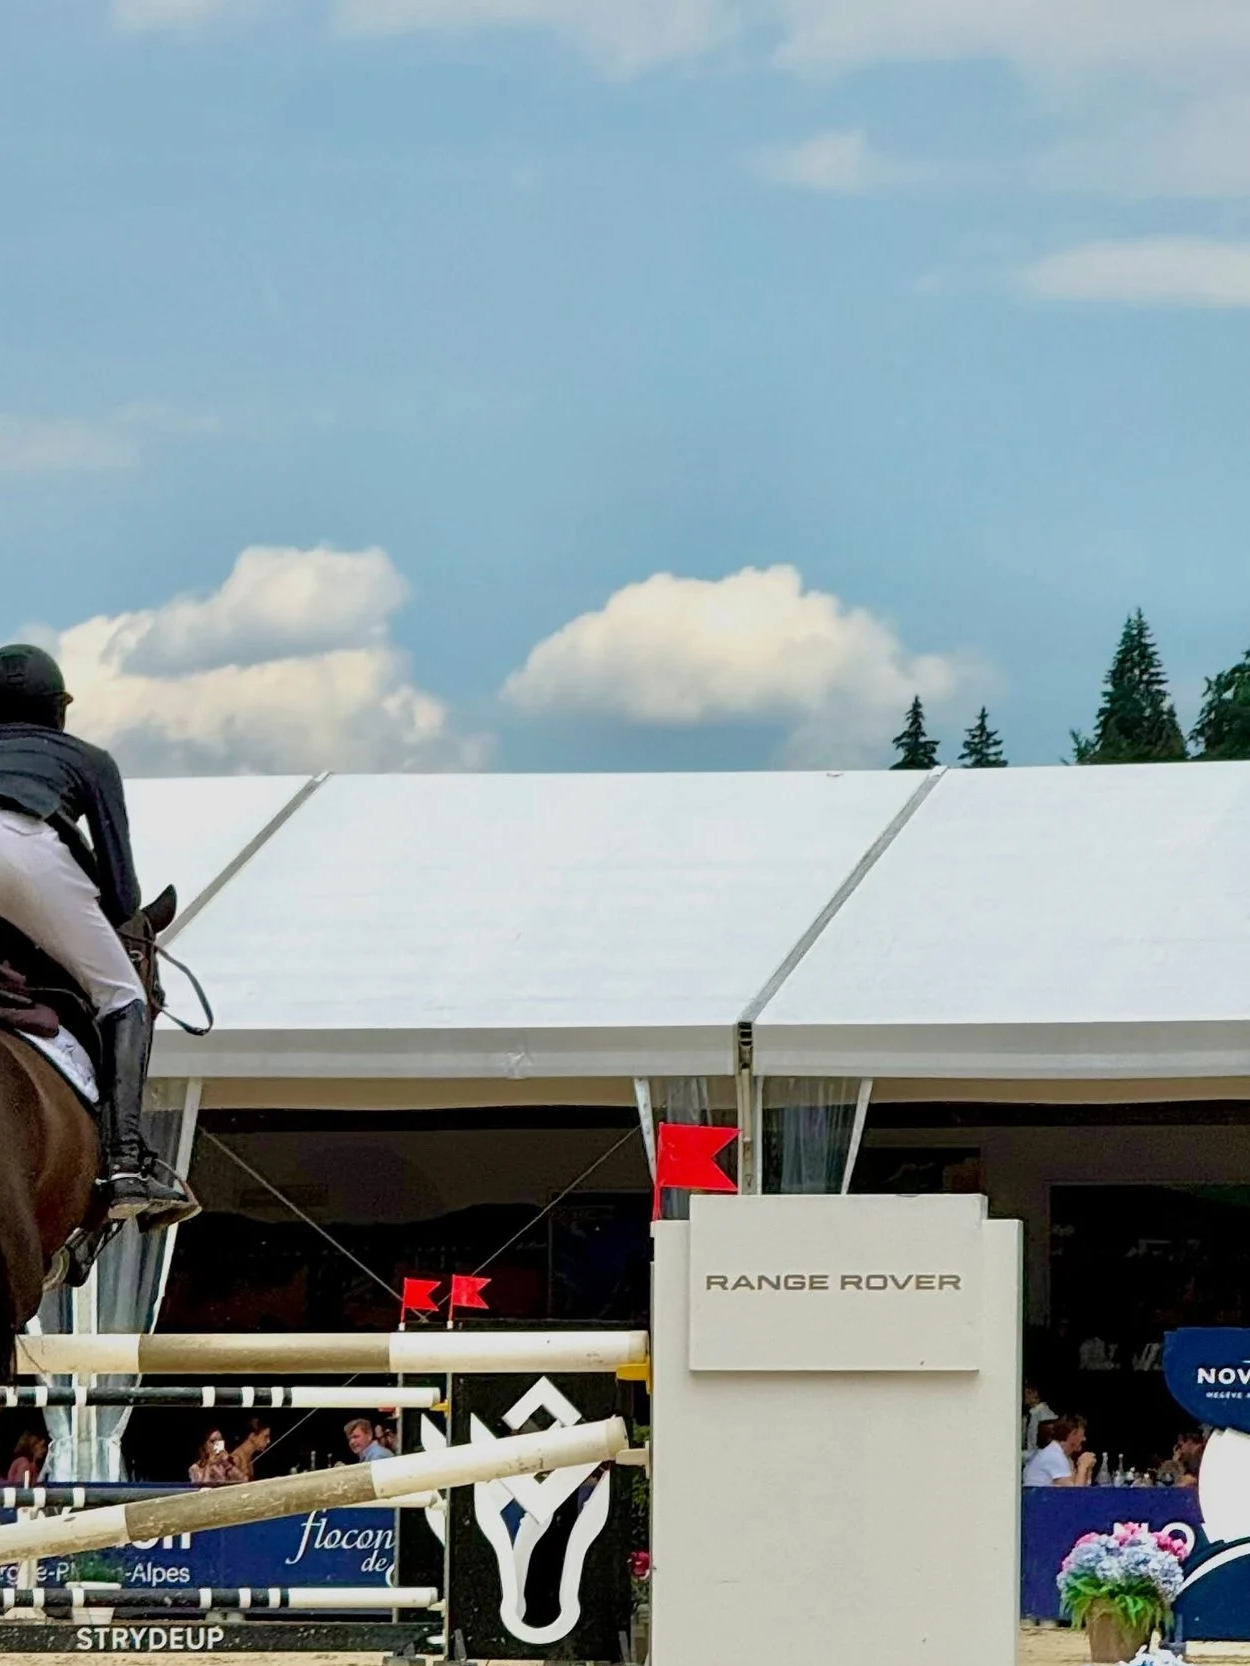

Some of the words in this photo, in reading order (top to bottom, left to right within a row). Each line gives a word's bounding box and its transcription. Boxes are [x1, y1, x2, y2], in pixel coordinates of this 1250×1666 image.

[705, 1274, 830, 1291] RANGE
[840, 1274, 962, 1291] ROVER
[360, 1550, 389, 1572] de
[76, 1626, 224, 1650] STRYDEUP
